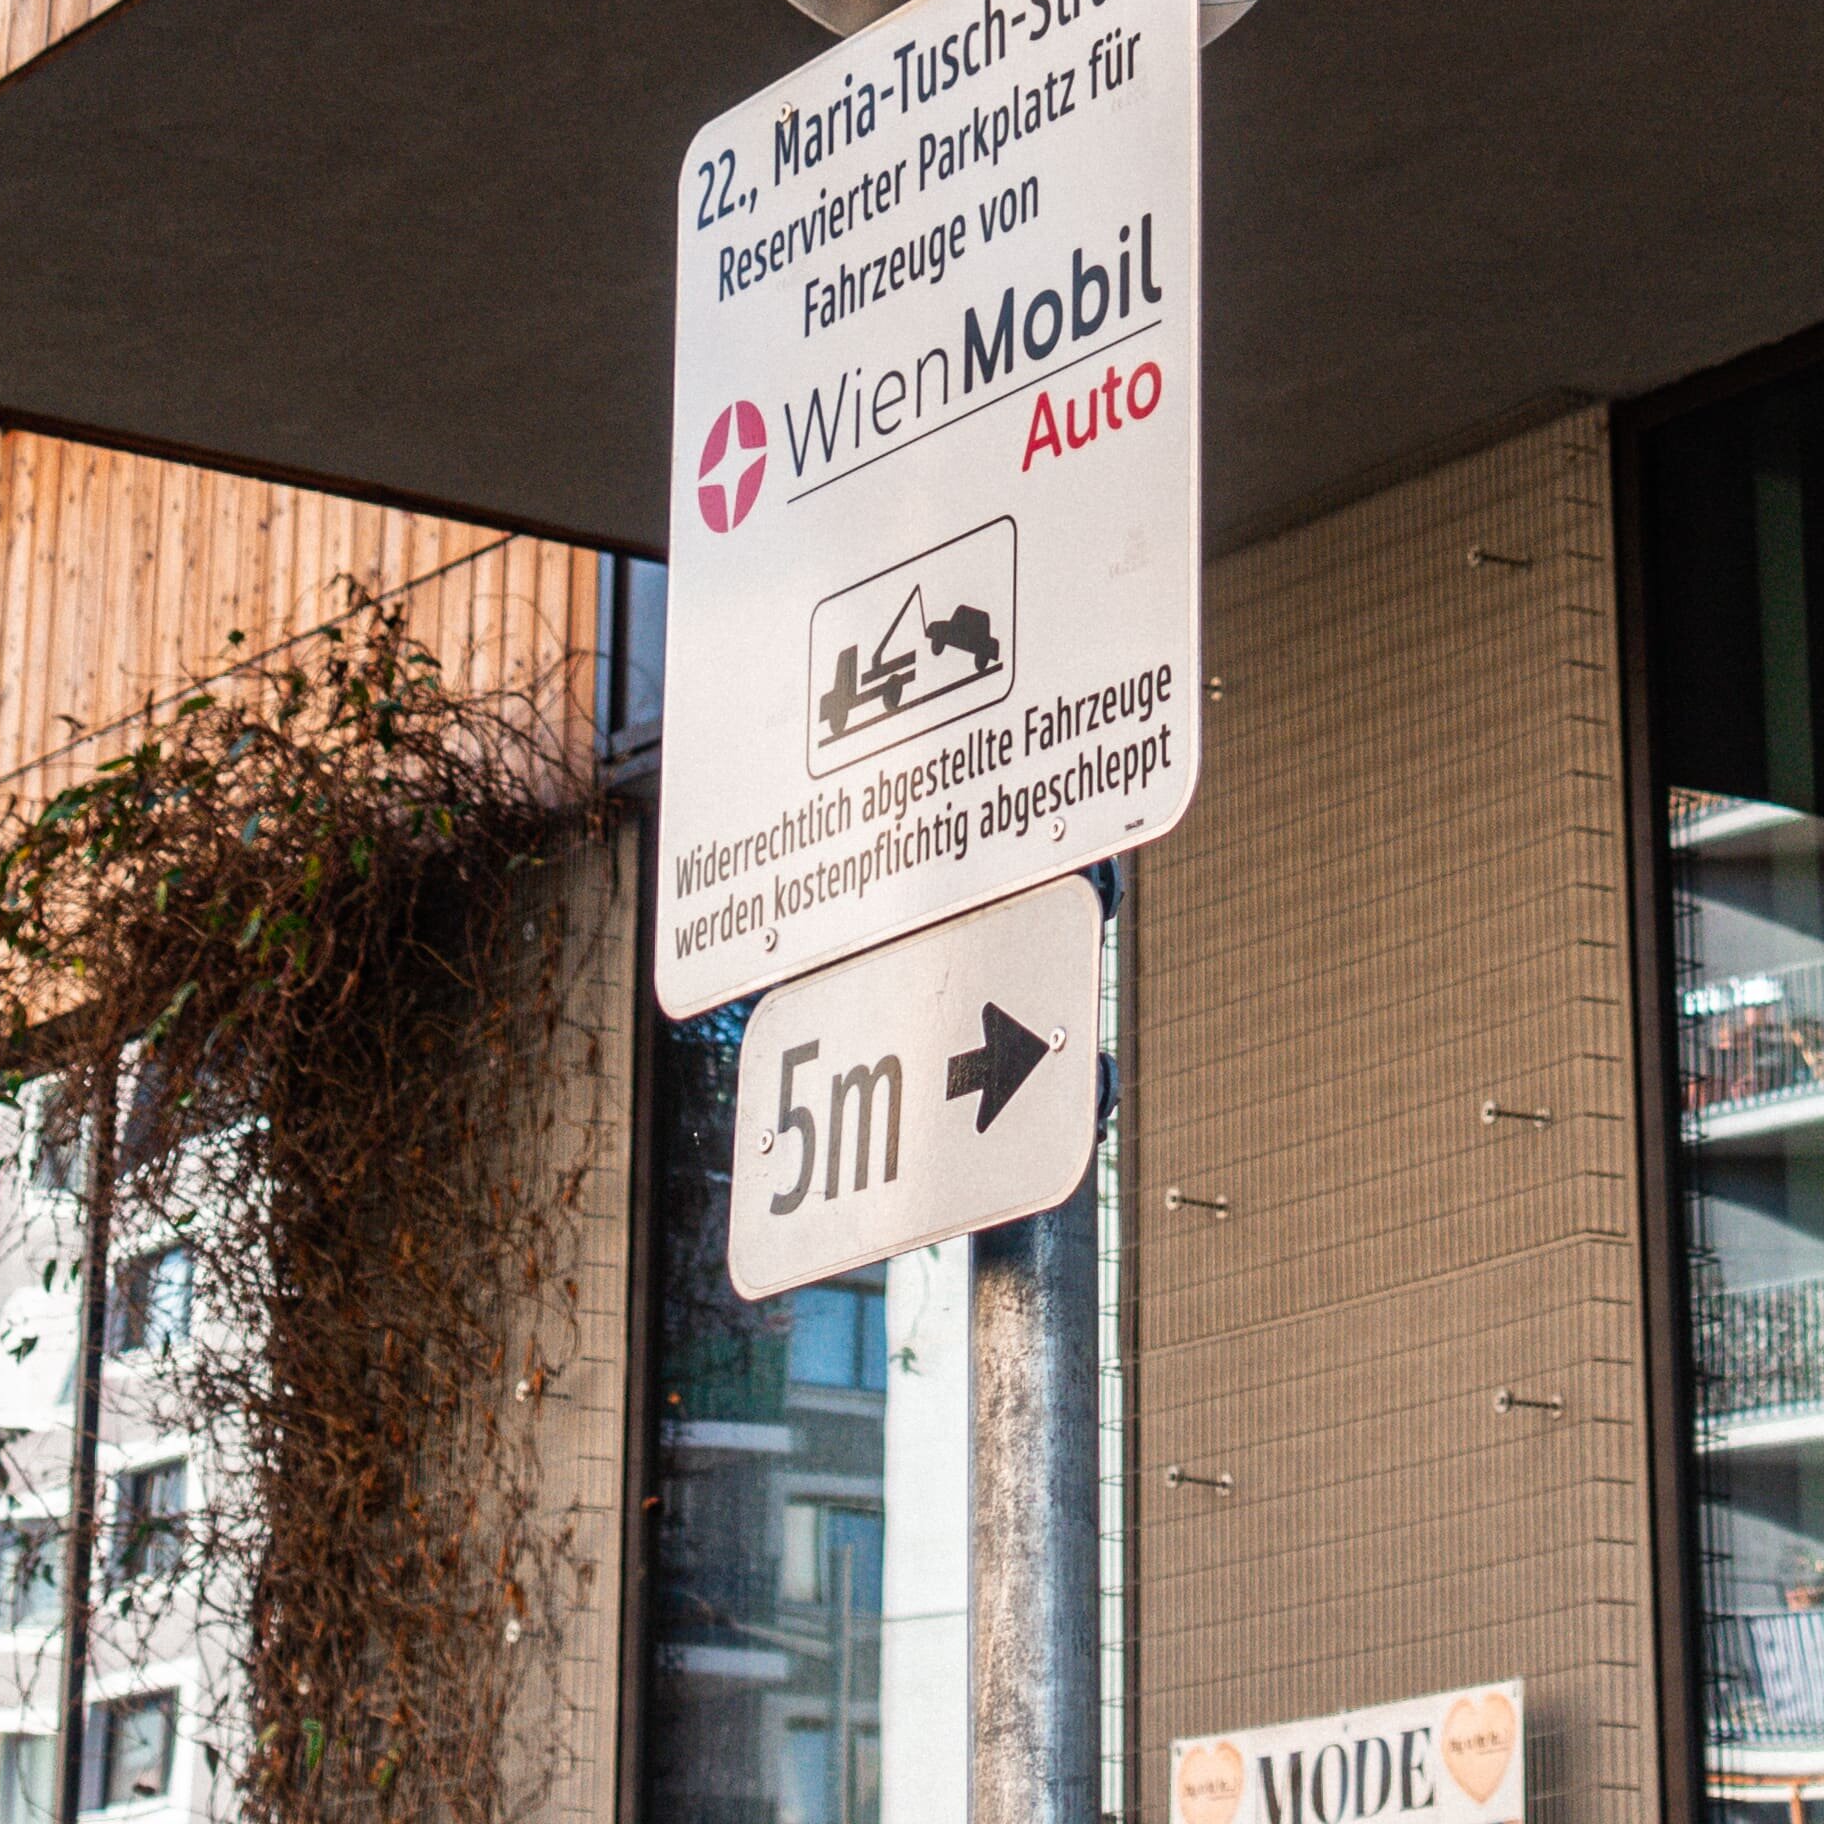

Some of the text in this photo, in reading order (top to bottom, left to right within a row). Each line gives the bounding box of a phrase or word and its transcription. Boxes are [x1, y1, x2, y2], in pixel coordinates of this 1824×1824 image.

[697, 148, 758, 231] 22.,
[718, 26, 1141, 302] Reservierter Parkplatz für
[804, 174, 1039, 338] Fahrzeuge von
[784, 212, 1162, 477] WienMobil
[1021, 360, 1162, 472] Auto
[675, 723, 1172, 960] werden kostenpflichtig abgeschleppt
[676, 663, 1172, 899] Widerrechtlich abgestellte Fahrzeuge
[770, 1039, 903, 1215] 5m
[1256, 1727, 1434, 1824] MODE
